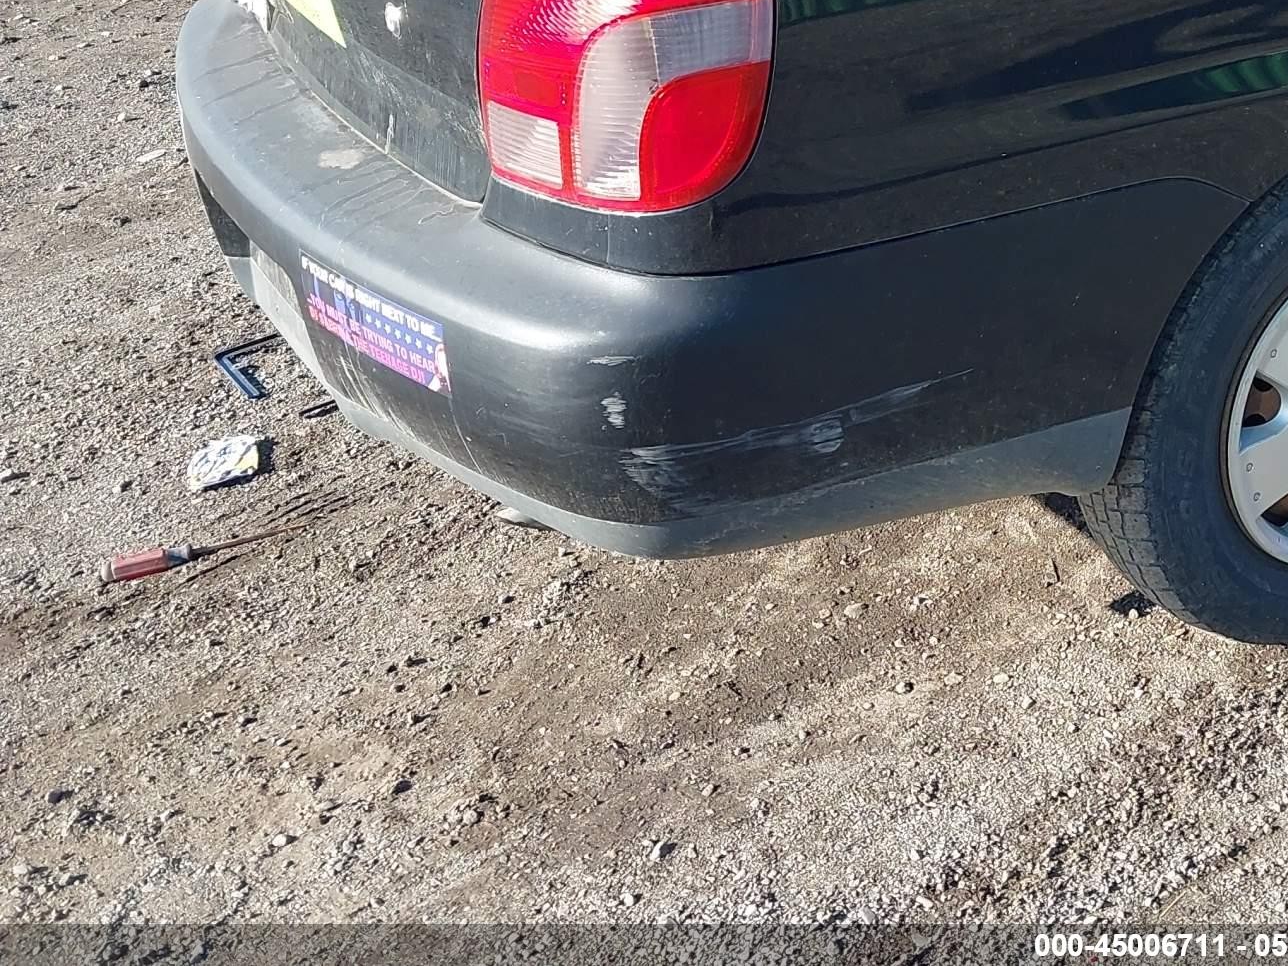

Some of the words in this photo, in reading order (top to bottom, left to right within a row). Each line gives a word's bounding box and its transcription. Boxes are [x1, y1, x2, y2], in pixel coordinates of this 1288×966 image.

[405, 313, 420, 332] TO
[361, 326, 394, 353] TRYING
[394, 343, 408, 360] TO
[408, 351, 435, 374] HEAR
